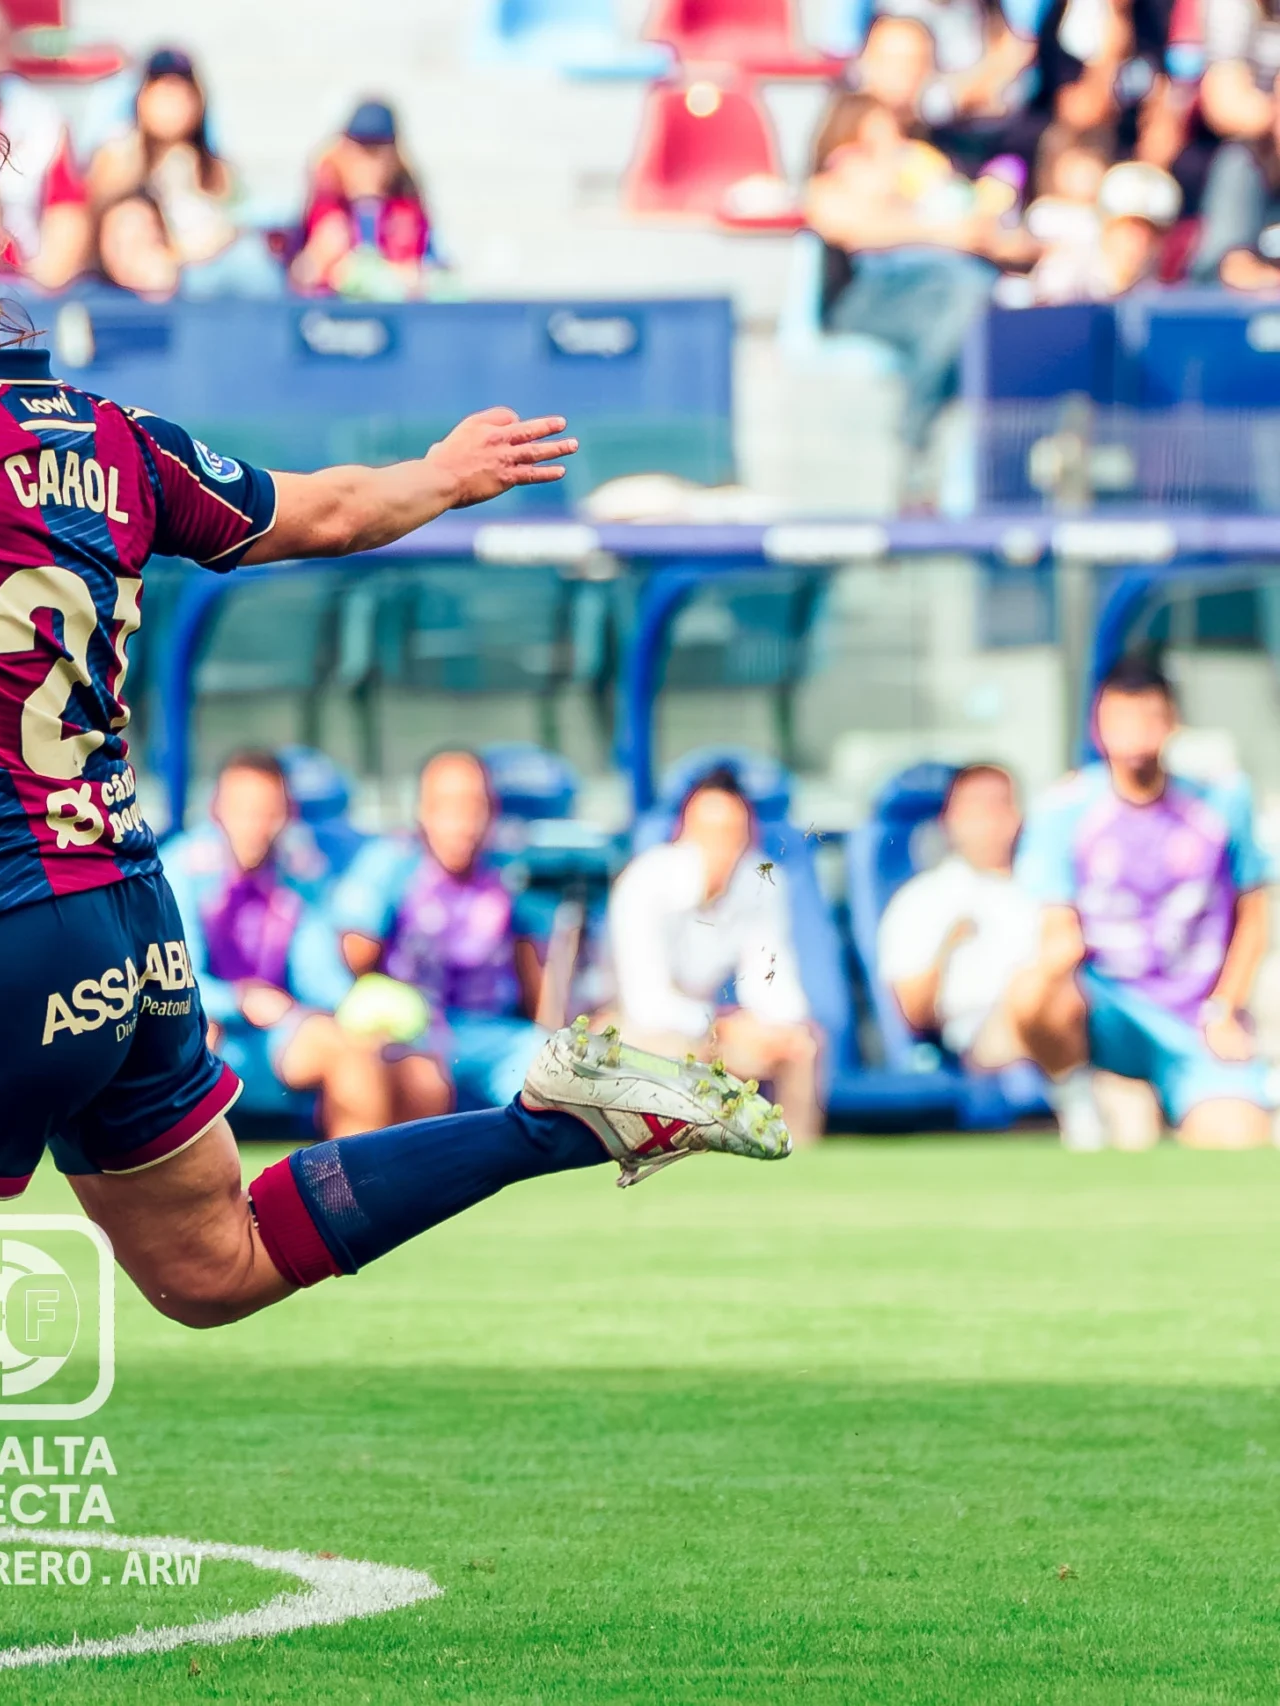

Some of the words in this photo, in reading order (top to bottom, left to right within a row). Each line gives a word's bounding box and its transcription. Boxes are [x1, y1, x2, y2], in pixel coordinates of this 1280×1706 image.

[4, 449, 129, 524] CAROL
[41, 956, 140, 1046] ASSA
[139, 940, 196, 990] ABL
[140, 993, 191, 1016] Peatonal
